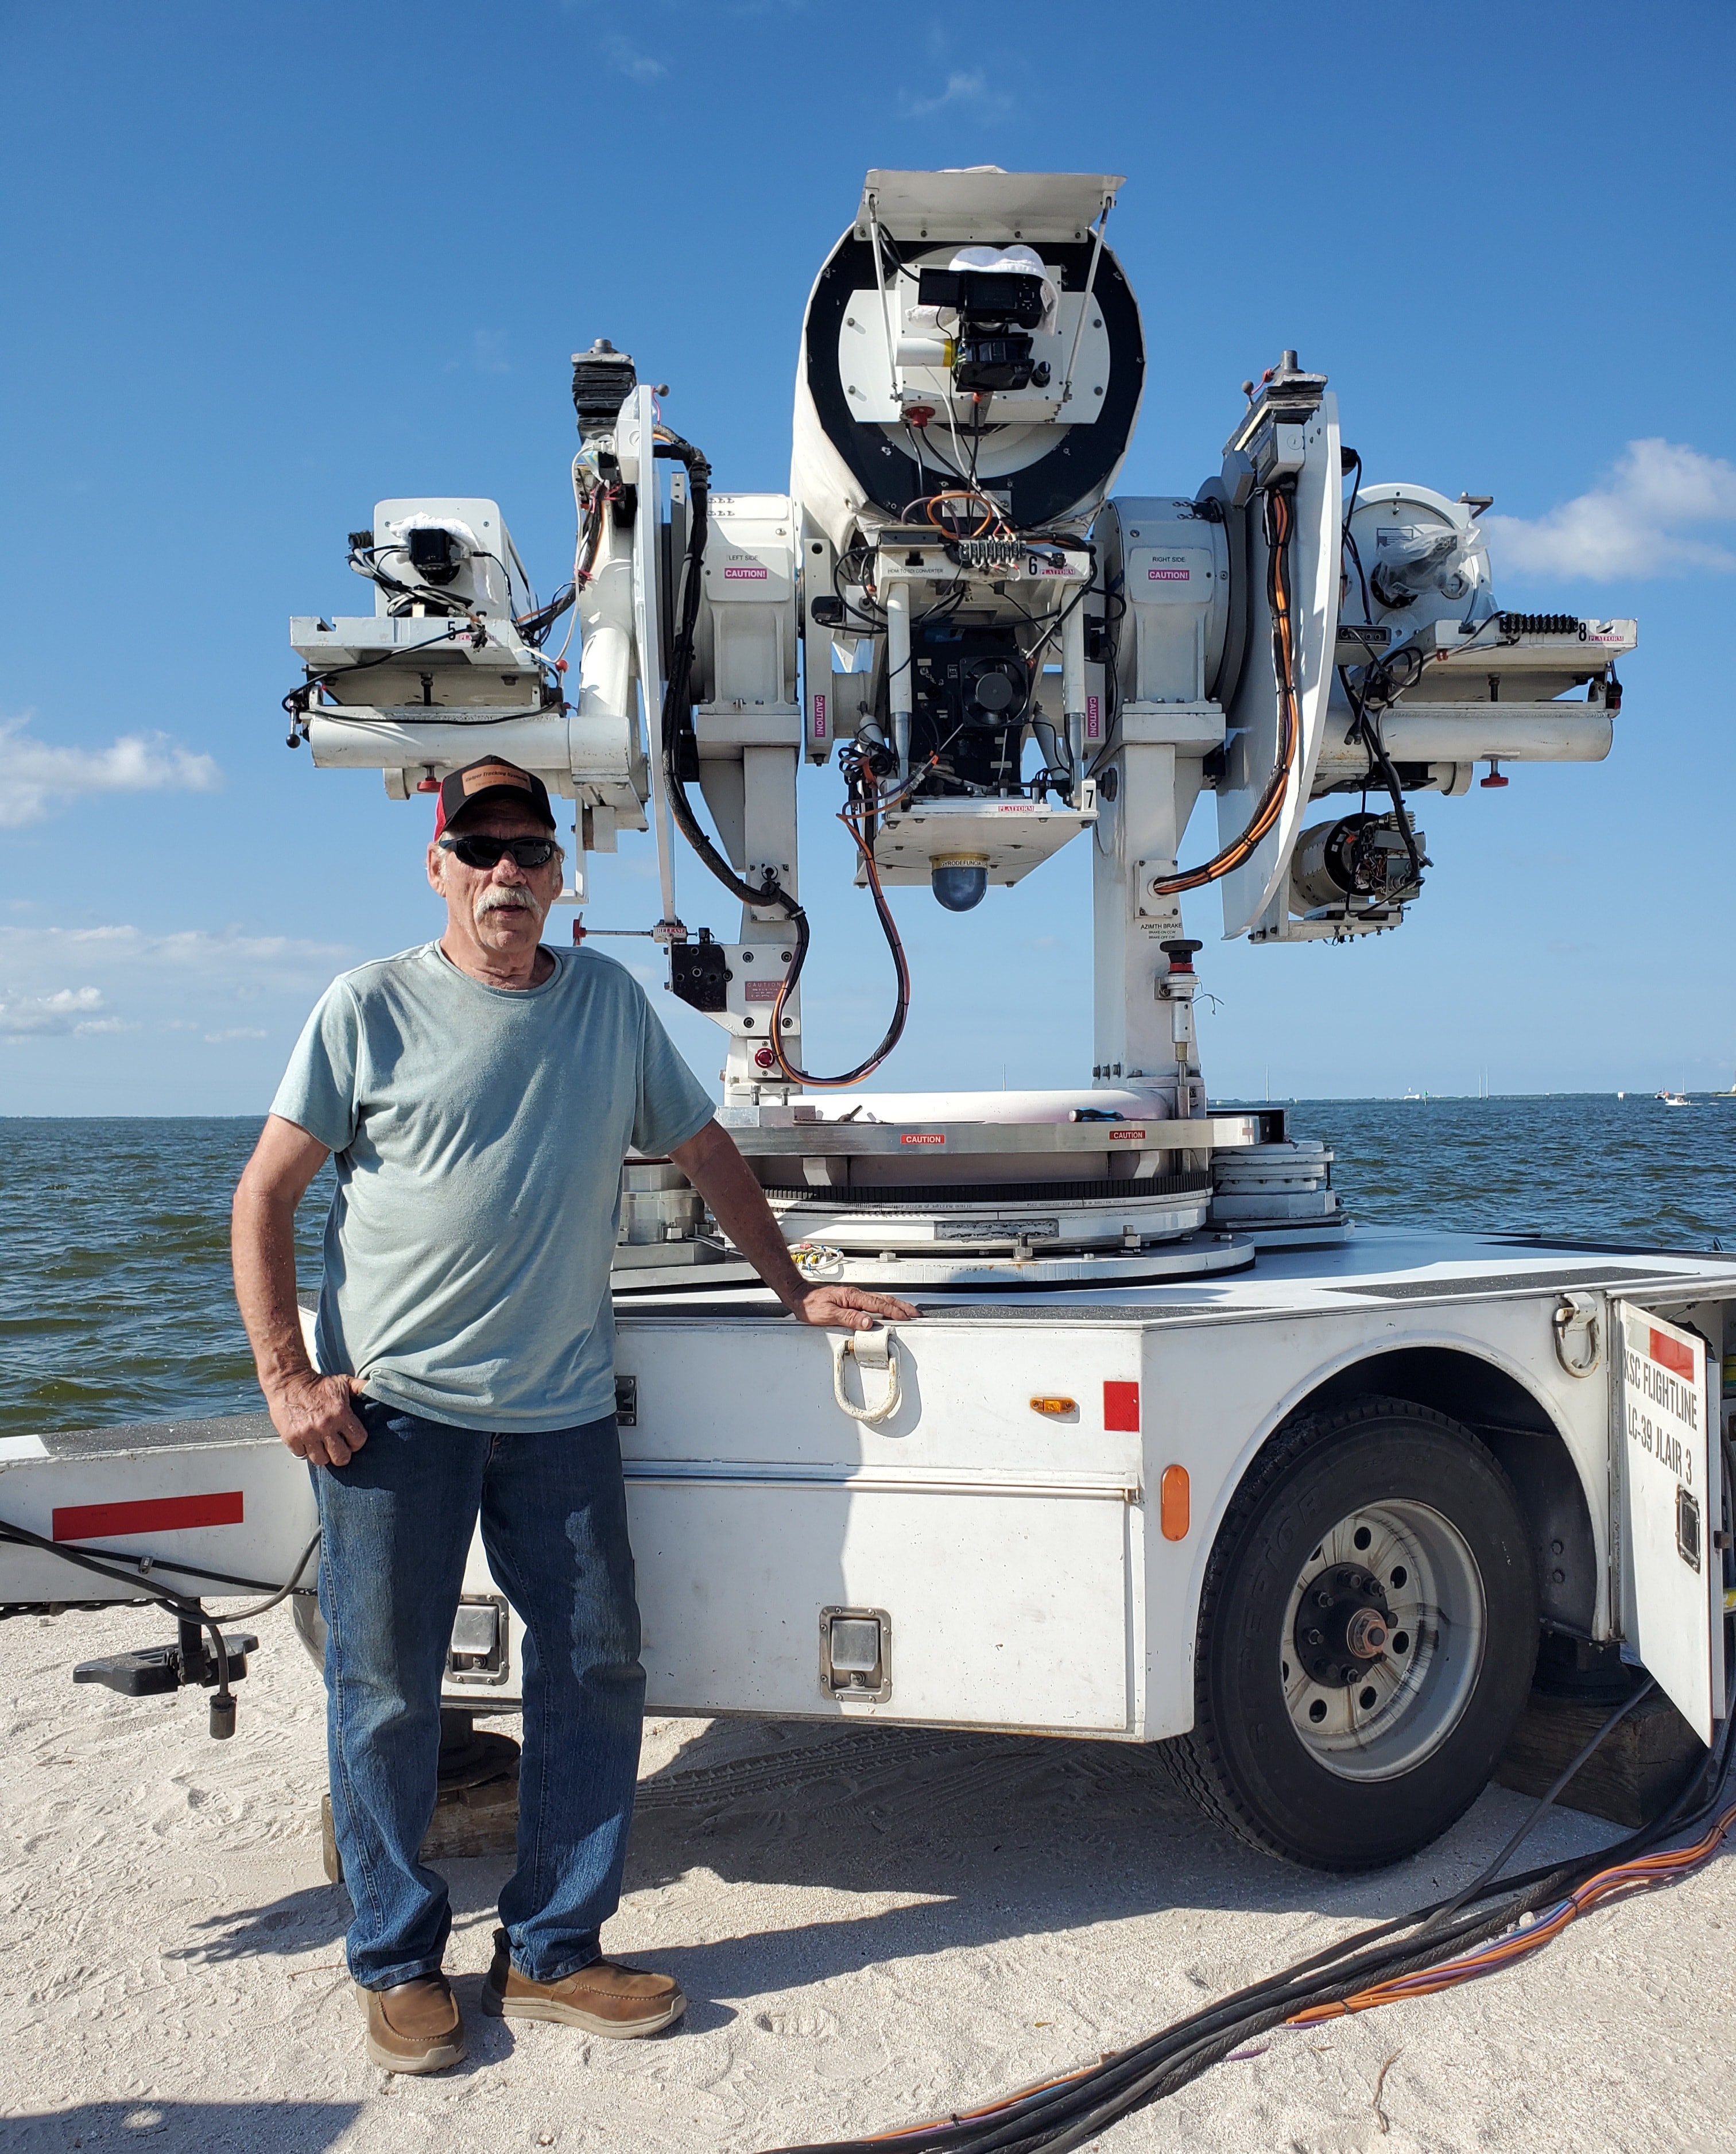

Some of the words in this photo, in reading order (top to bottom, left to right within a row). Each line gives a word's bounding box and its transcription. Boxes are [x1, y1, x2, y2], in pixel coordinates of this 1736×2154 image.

[725, 570, 766, 578] CAUTION!
[1028, 556, 1038, 576] 6
[1149, 571, 1188, 579] CAUTION!
[448, 621, 456, 641] 5
[1578, 622, 1587, 642] 8
[816, 695, 824, 735] CAUTION!
[1089, 697, 1097, 737] CAUTION!
[1086, 789, 1094, 809] 7
[1113, 1132, 1143, 1140] CAUTION
[1624, 1349, 1641, 1390] KSC
[1643, 1361, 1698, 1432] FLIGHTLINE
[1628, 1403, 1652, 1454] LC-39
[1685, 1448, 1692, 1486] 3
